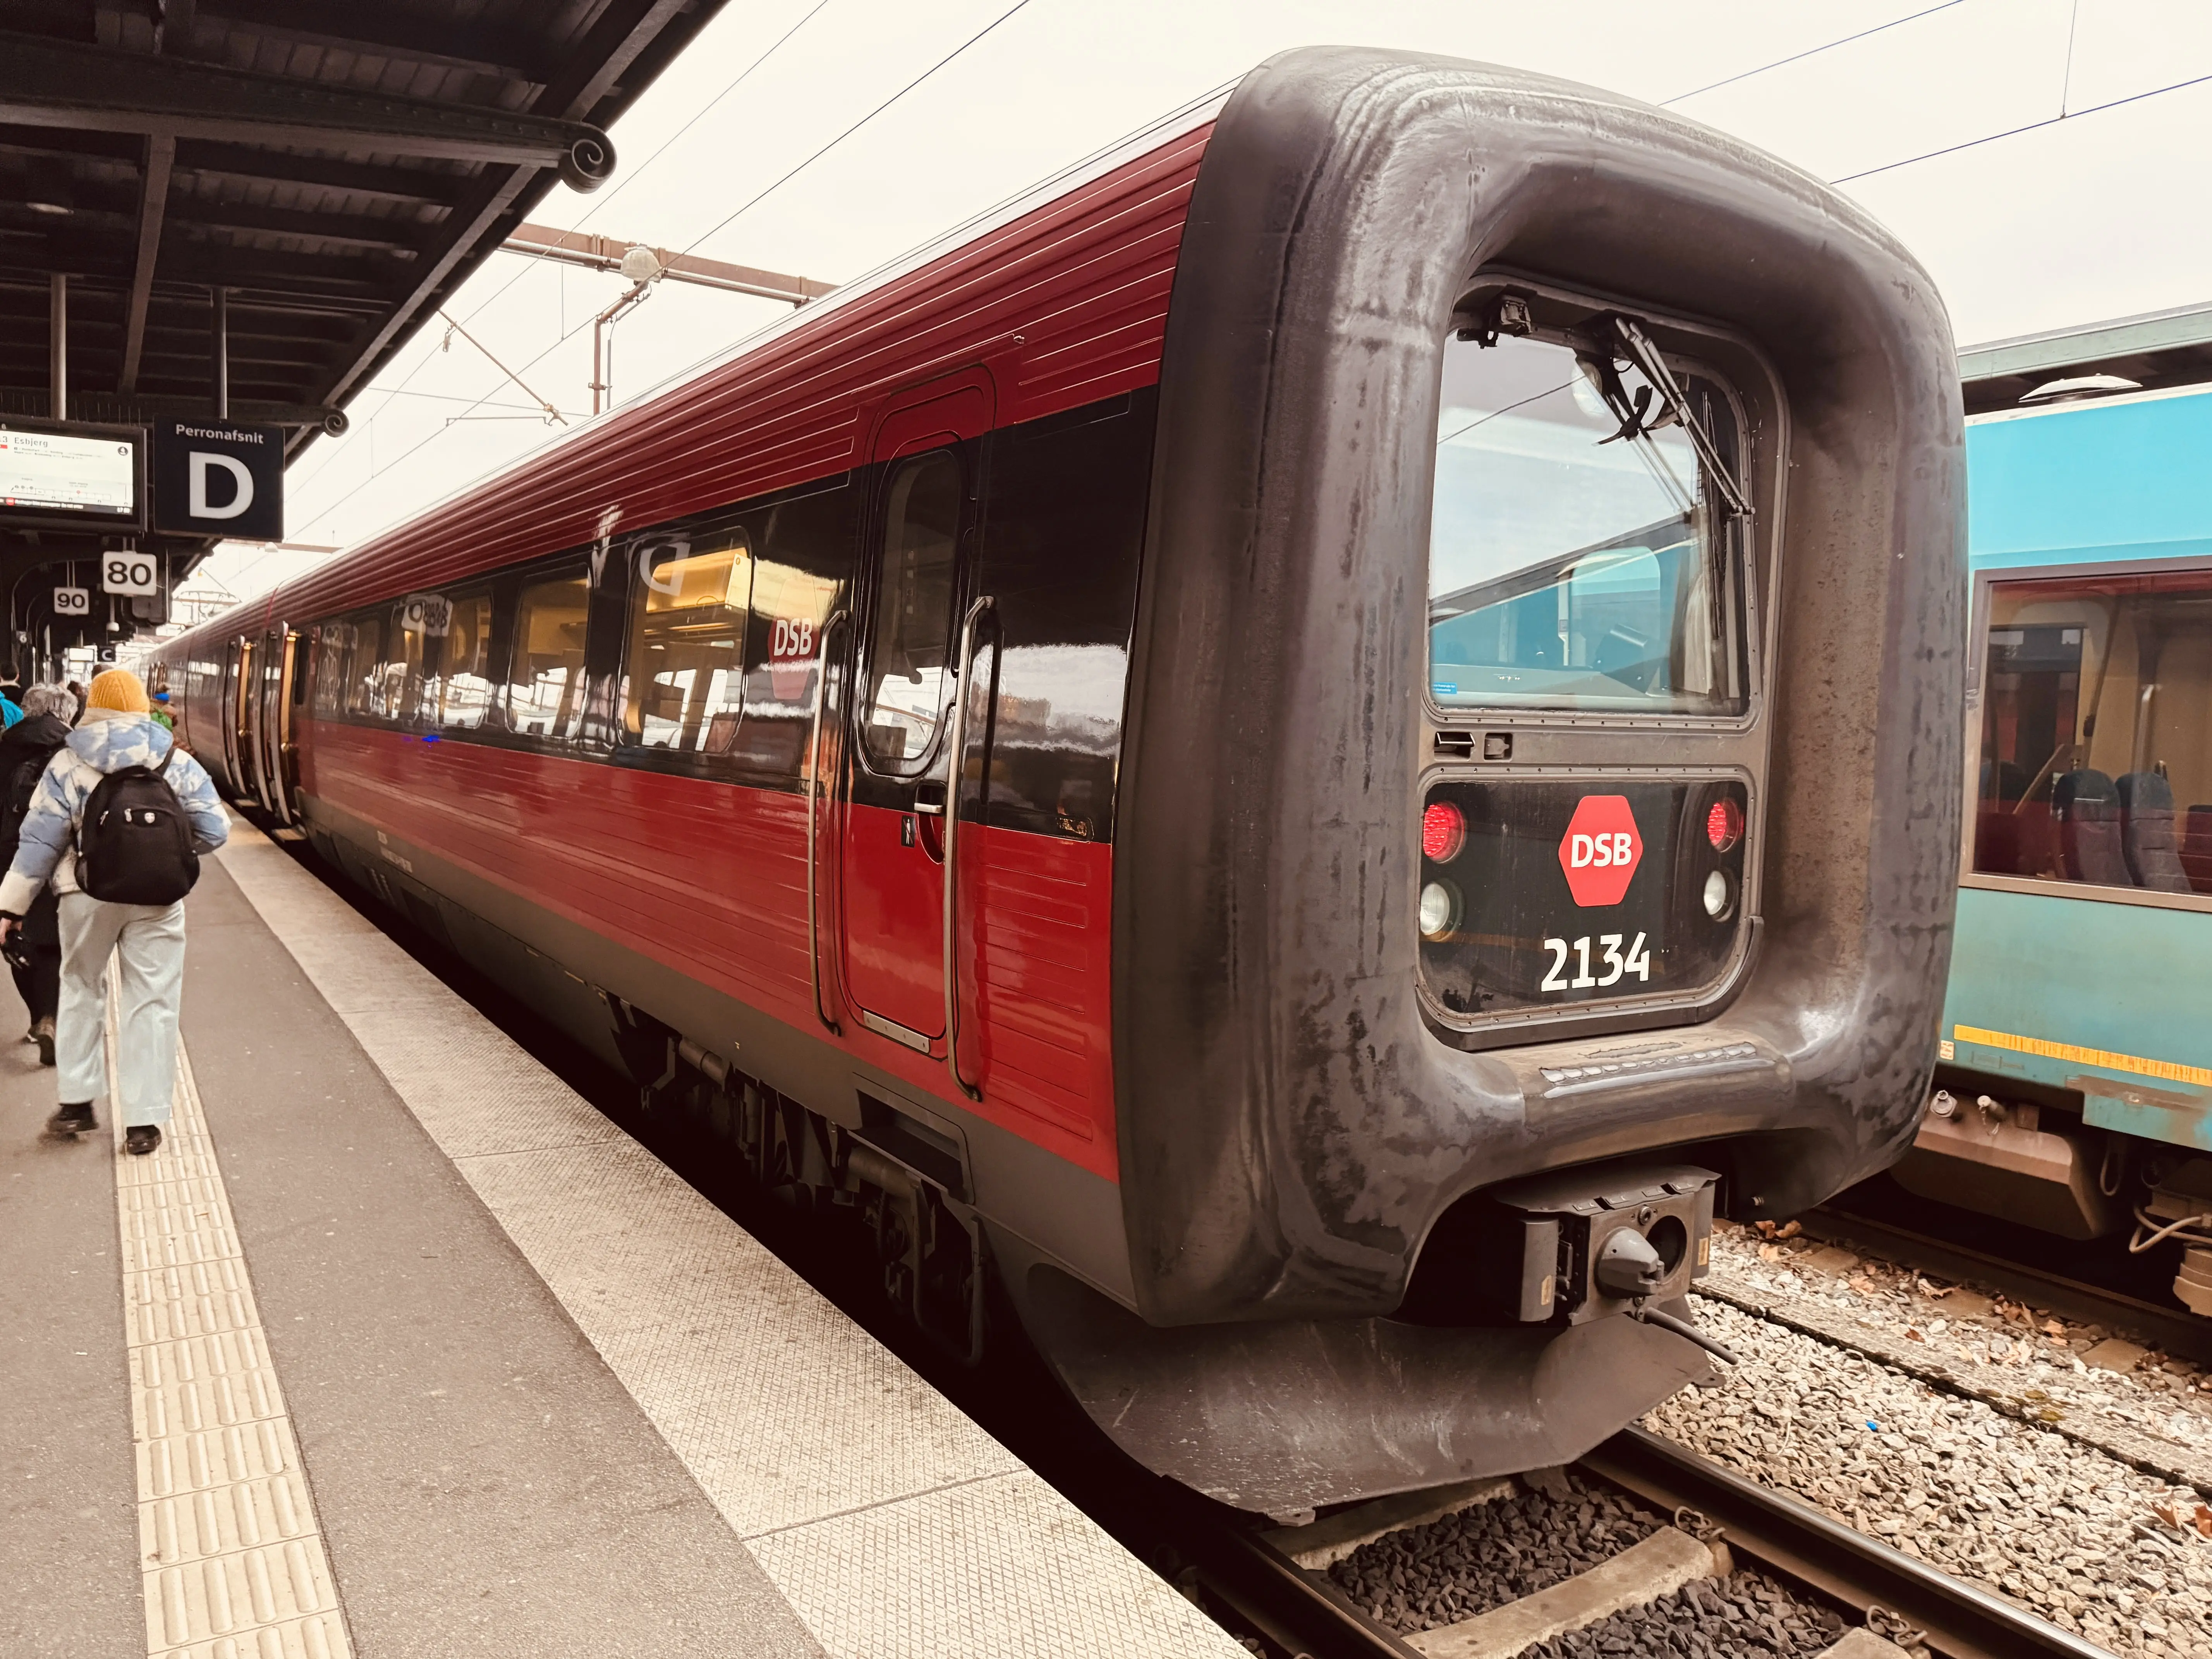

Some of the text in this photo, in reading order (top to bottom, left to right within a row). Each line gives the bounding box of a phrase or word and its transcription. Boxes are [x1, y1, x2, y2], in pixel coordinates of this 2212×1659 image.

[14, 437, 48, 448] Esbjerg
[176, 424, 264, 445] Perronafsnit
[189, 452, 254, 519] D
[107, 562, 151, 586] 80
[57, 593, 85, 608] 90
[774, 618, 812, 656] DSB
[101, 649, 112, 661] C
[1571, 833, 1632, 867] DSB
[1541, 932, 1650, 992] 2134
